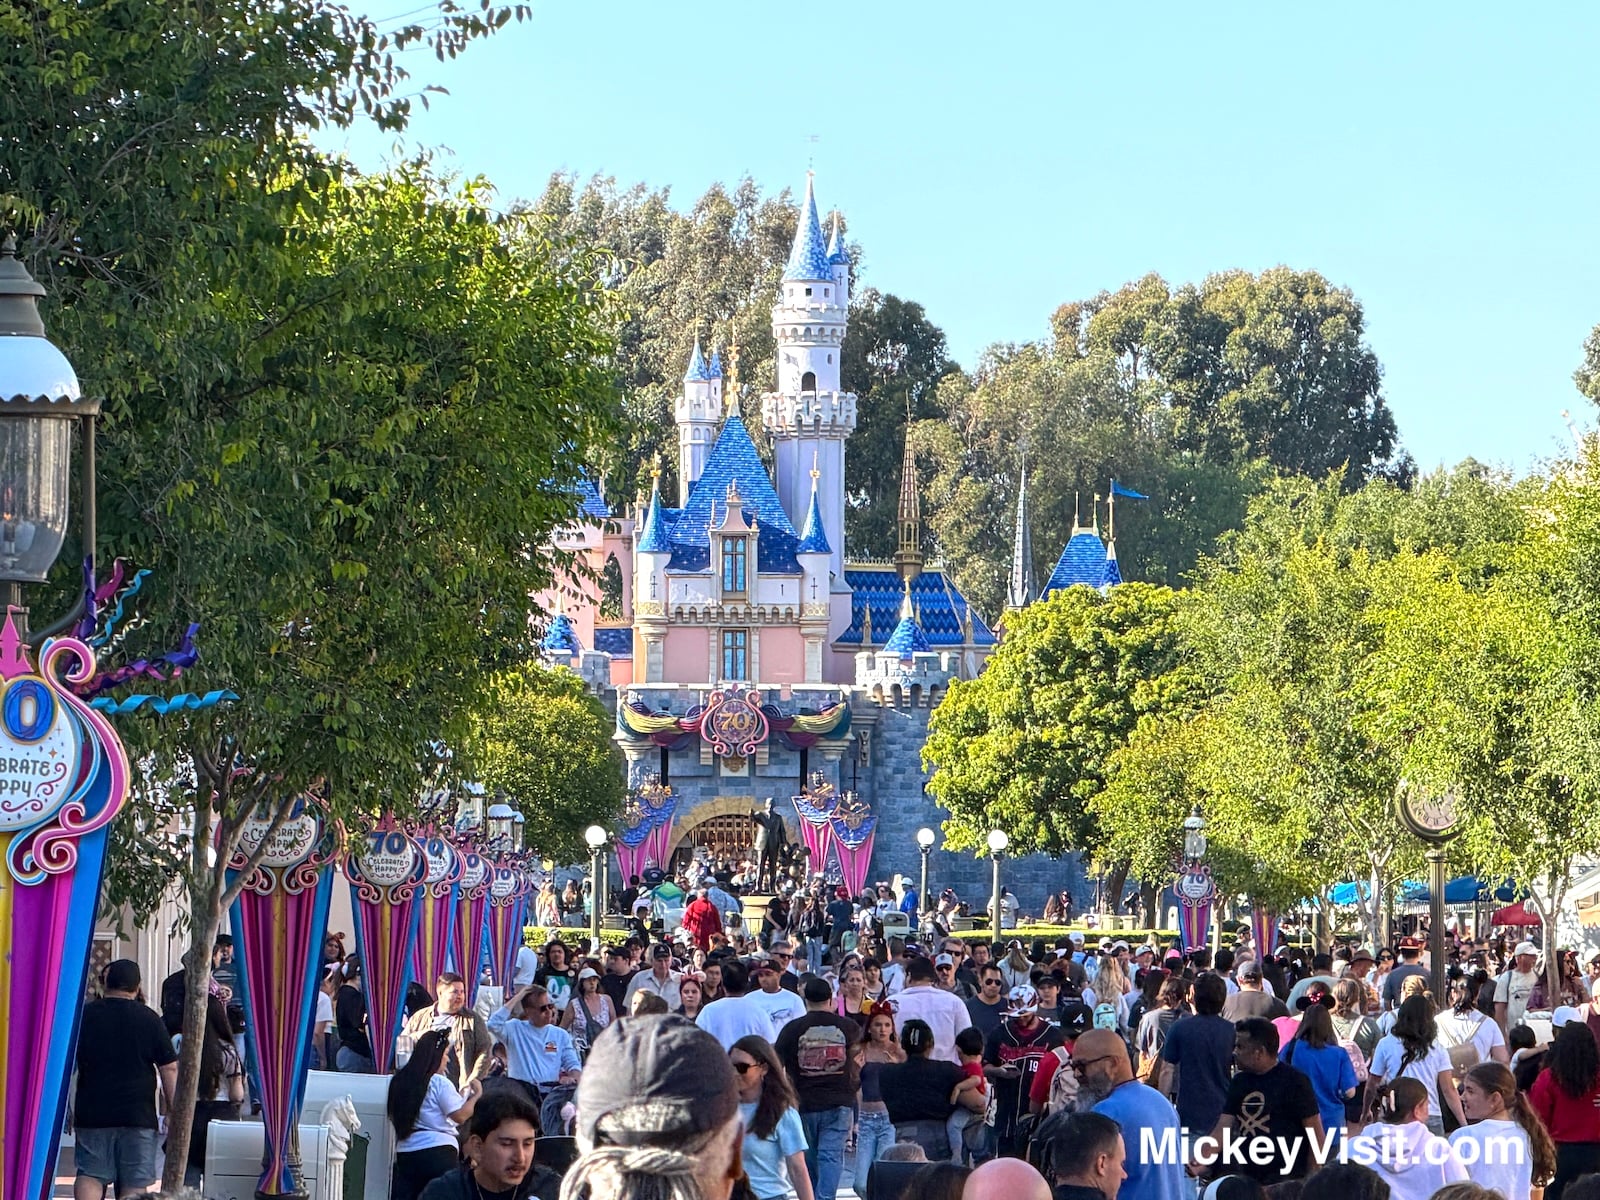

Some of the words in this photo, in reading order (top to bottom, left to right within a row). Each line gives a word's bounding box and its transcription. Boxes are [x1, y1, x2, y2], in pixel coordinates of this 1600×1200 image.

[720, 712, 750, 730] 70
[370, 831, 407, 855] 70
[1028, 1059, 1039, 1073] 19
